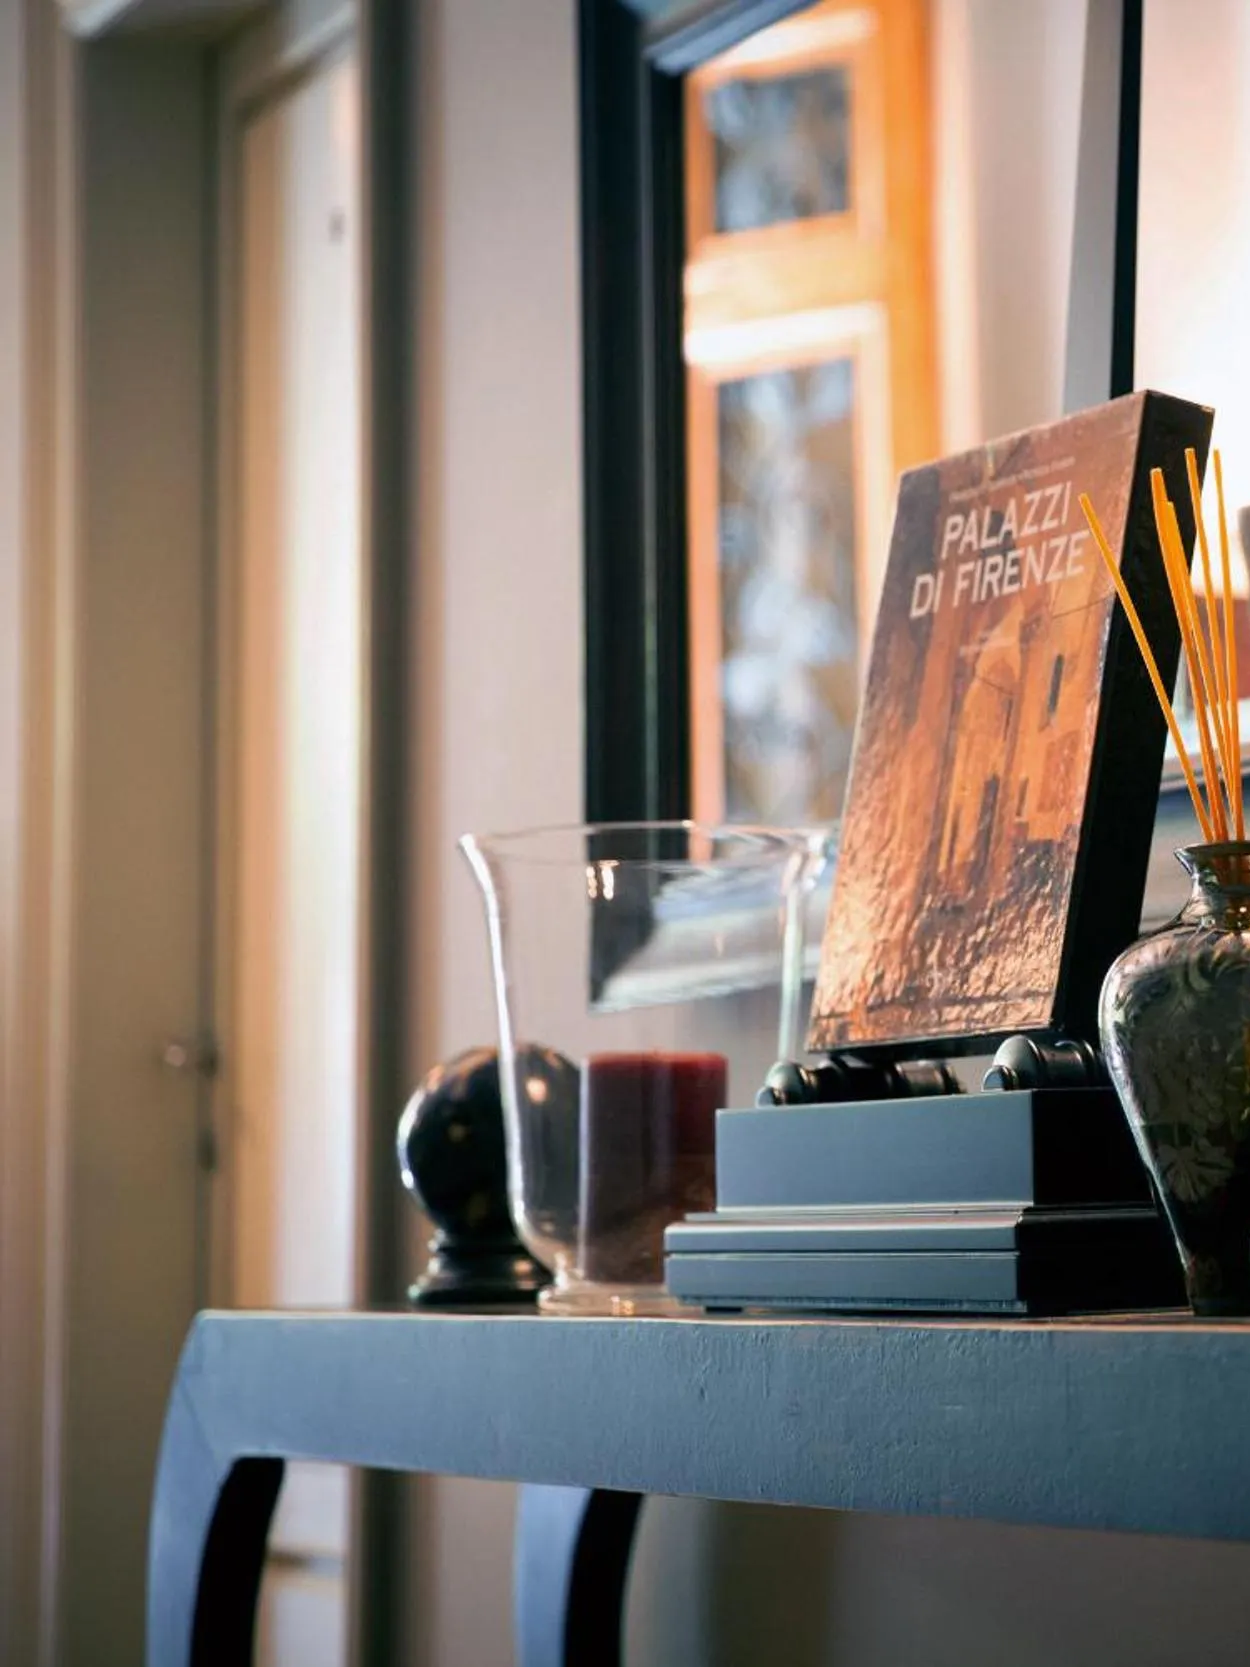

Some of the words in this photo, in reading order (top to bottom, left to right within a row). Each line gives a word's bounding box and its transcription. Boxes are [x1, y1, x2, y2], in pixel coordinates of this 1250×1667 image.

[942, 481, 1072, 559] PALAZZI
[910, 572, 944, 619] DI
[953, 530, 1090, 608] FIRENZE
